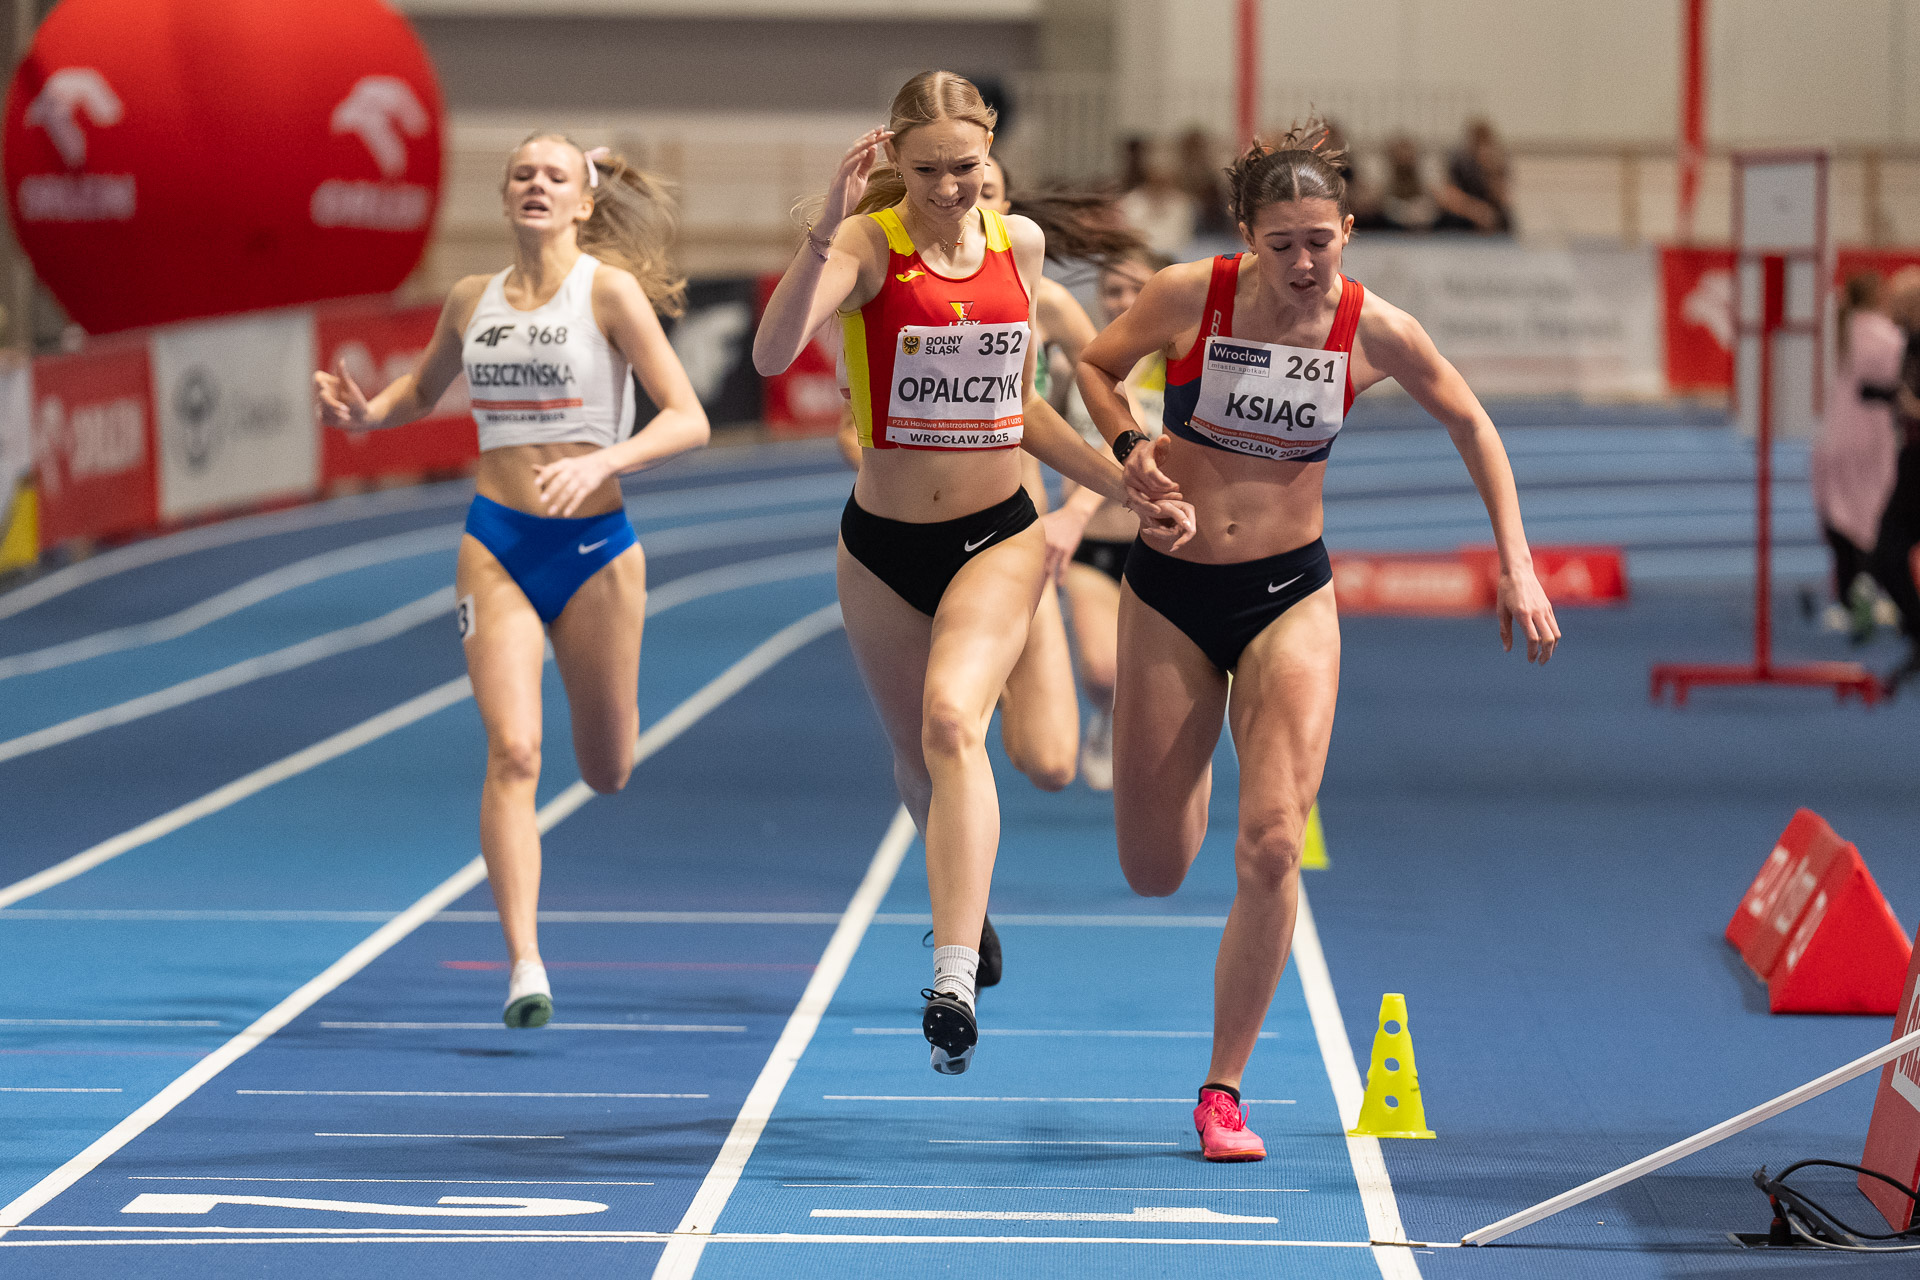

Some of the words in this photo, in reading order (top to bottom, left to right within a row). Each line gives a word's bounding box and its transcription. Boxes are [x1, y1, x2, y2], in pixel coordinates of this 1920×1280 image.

[528, 325, 568, 346] 968
[926, 335, 963, 346] DOLNY
[978, 330, 1023, 356] 352
[925, 345, 960, 356] ŚLĄSK
[1213, 345, 1268, 364] Wrocław
[468, 359, 577, 387] LESZCZYŃSKA
[1211, 363, 1236, 371] miasto
[1238, 366, 1267, 375] spotkań
[1285, 355, 1335, 383] 261
[898, 372, 1019, 403] OPALCZYK
[1224, 392, 1317, 431] KSIĄG
[892, 419, 909, 427] PZLA
[910, 420, 937, 429] Halowe
[980, 420, 998, 429] Pols
[1011, 417, 1022, 425] U20
[910, 433, 979, 444] WROCŁAW
[982, 432, 1009, 444] 2025
[1210, 432, 1277, 456] WROCŁAW
[1238, 431, 1280, 445] Mistrzostwa
[120, 1193, 609, 1217] 2
